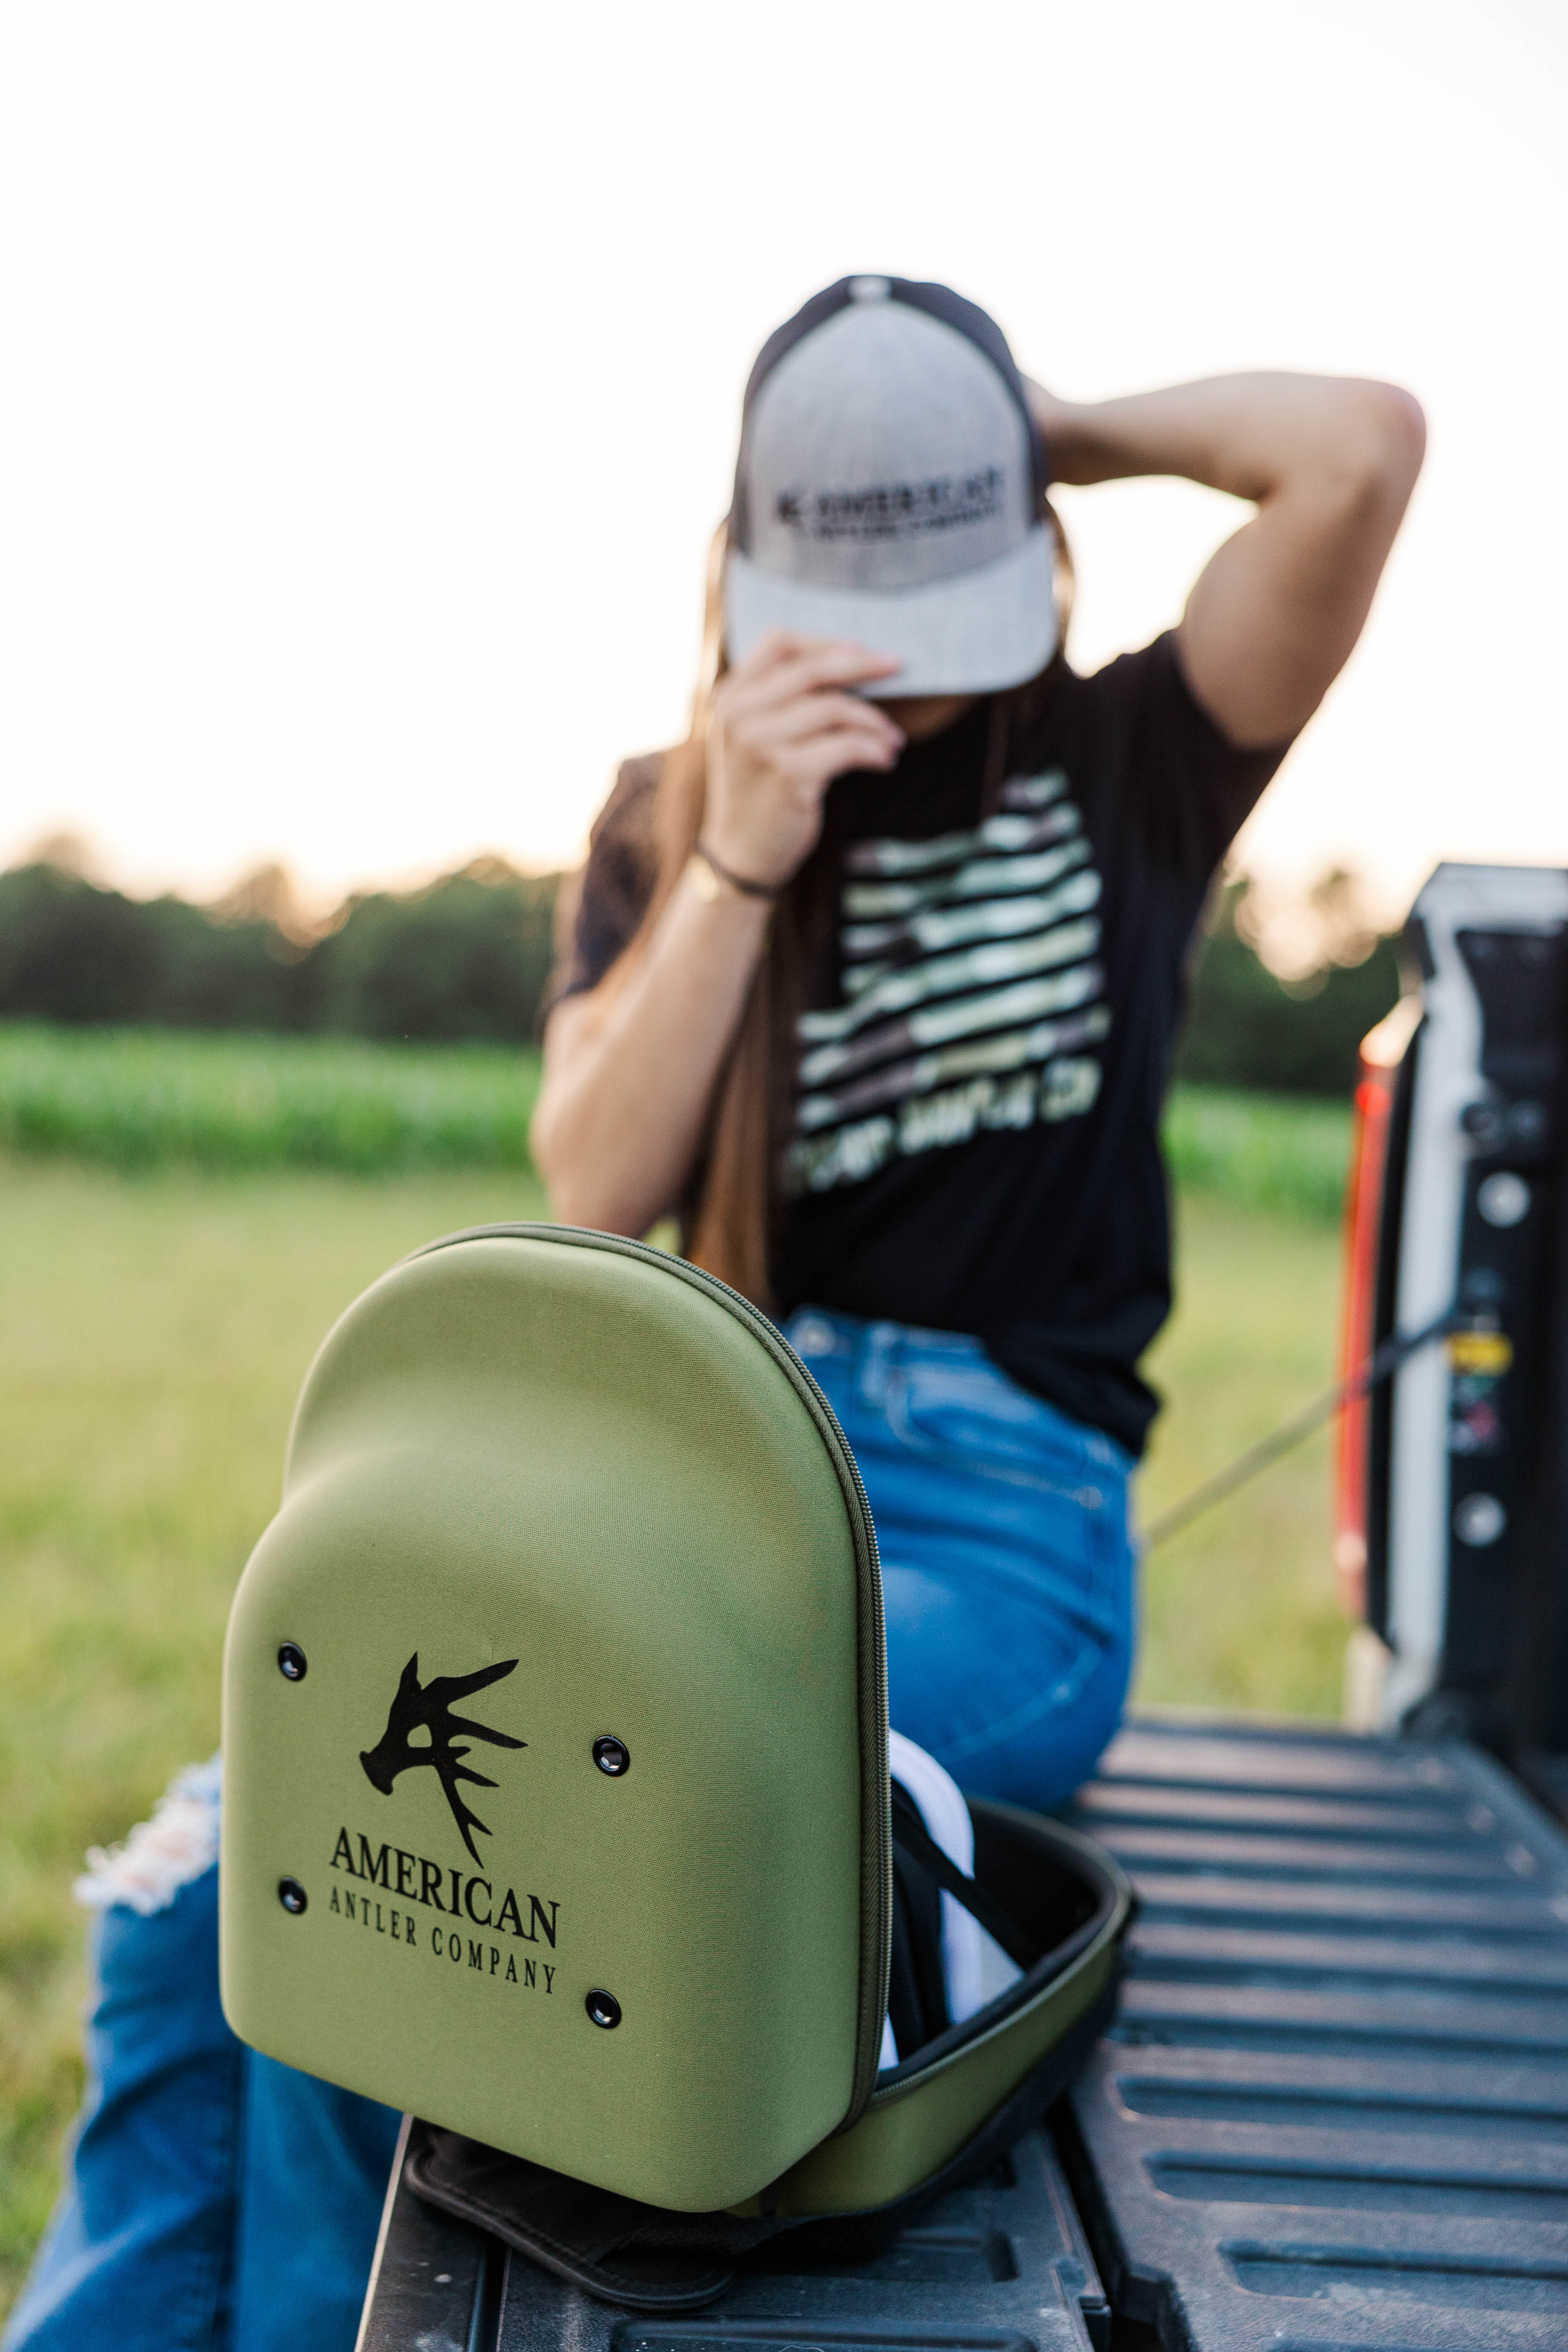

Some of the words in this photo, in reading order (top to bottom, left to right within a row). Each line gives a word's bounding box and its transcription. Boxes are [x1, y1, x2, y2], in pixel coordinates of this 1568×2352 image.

[330, 1826, 560, 1948] AMERICAN
[330, 1886, 417, 1946] ANTLER
[432, 1926, 556, 1994] COMPANY
